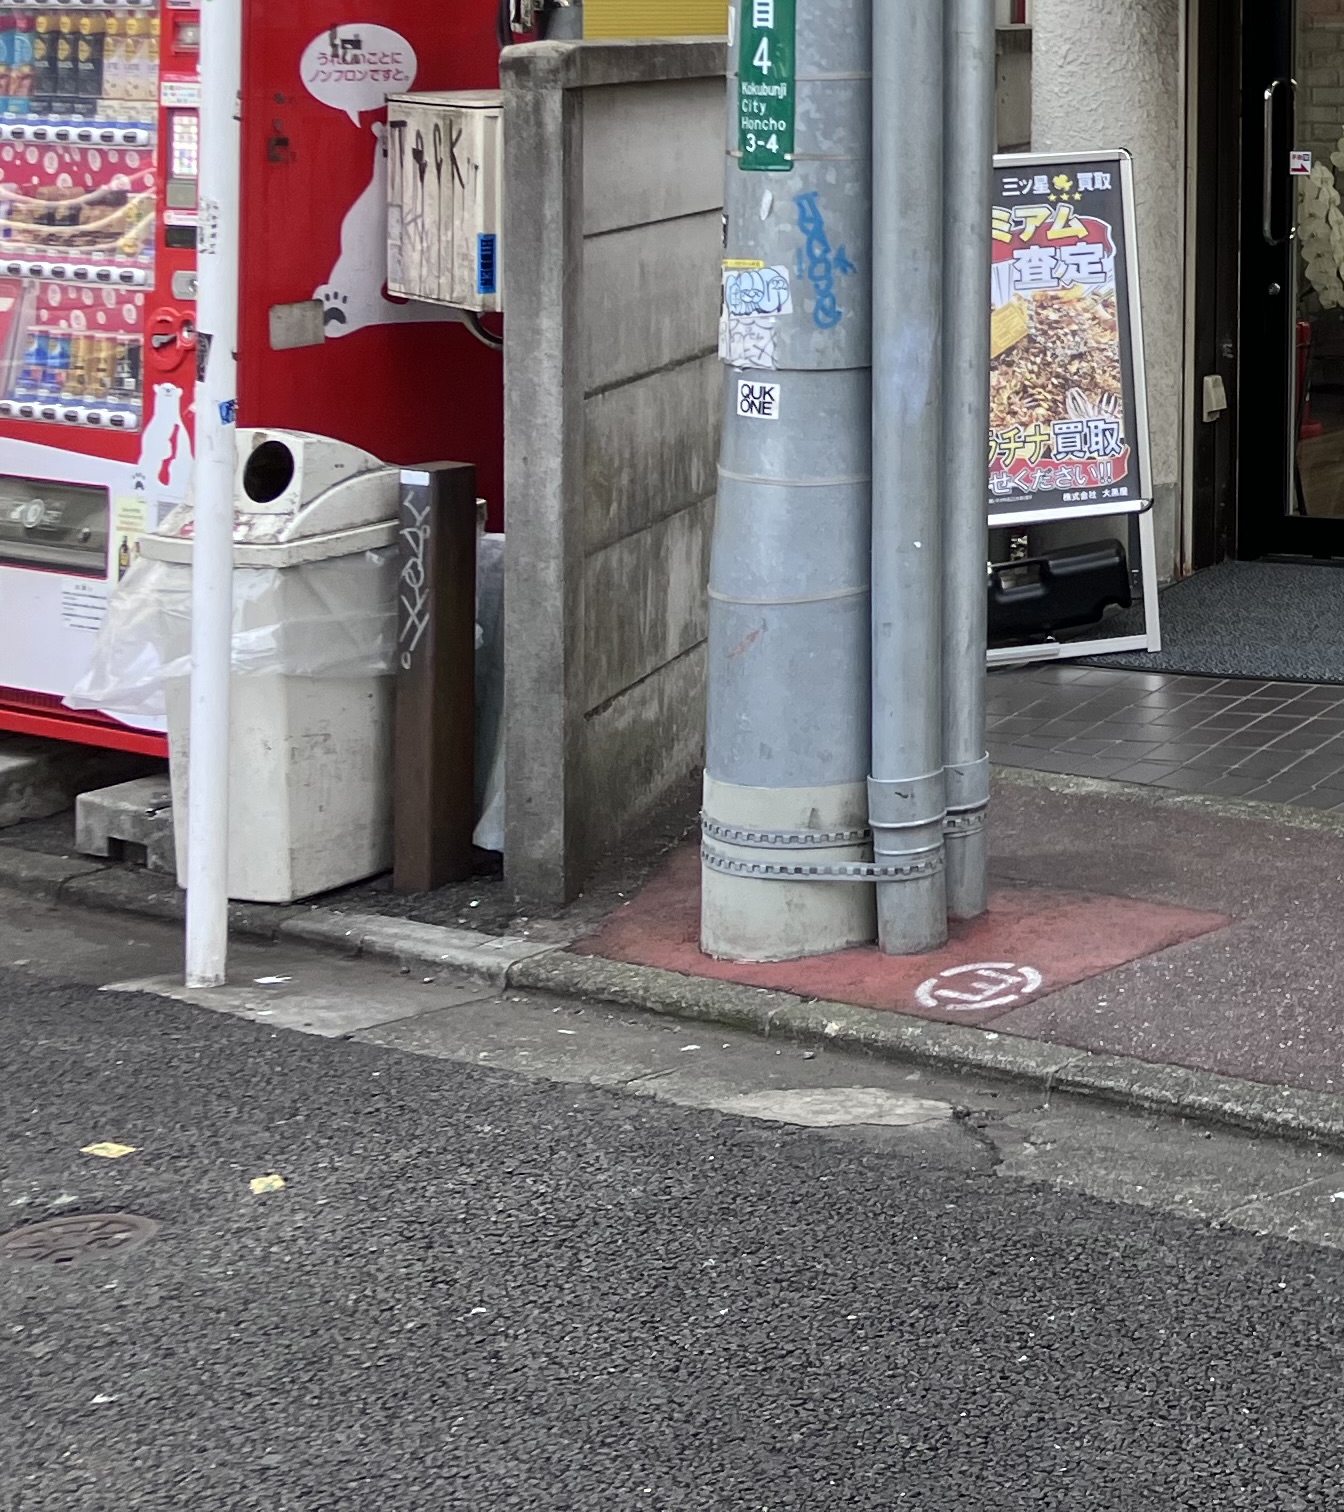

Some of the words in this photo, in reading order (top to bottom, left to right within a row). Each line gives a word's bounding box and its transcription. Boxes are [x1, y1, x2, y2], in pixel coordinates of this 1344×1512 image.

[741, 81, 788, 100] Kokubunji
[741, 100, 767, 116] City
[741, 116, 787, 132] Honcho
[745, 133, 780, 154] 3-4
[1002, 175, 1050, 196] 三ツ星
[1077, 171, 1112, 192] 買取
[1013, 243, 1109, 289] 査定
[740, 397, 773, 416] ONE
[1062, 490, 1097, 502] 株式会社
